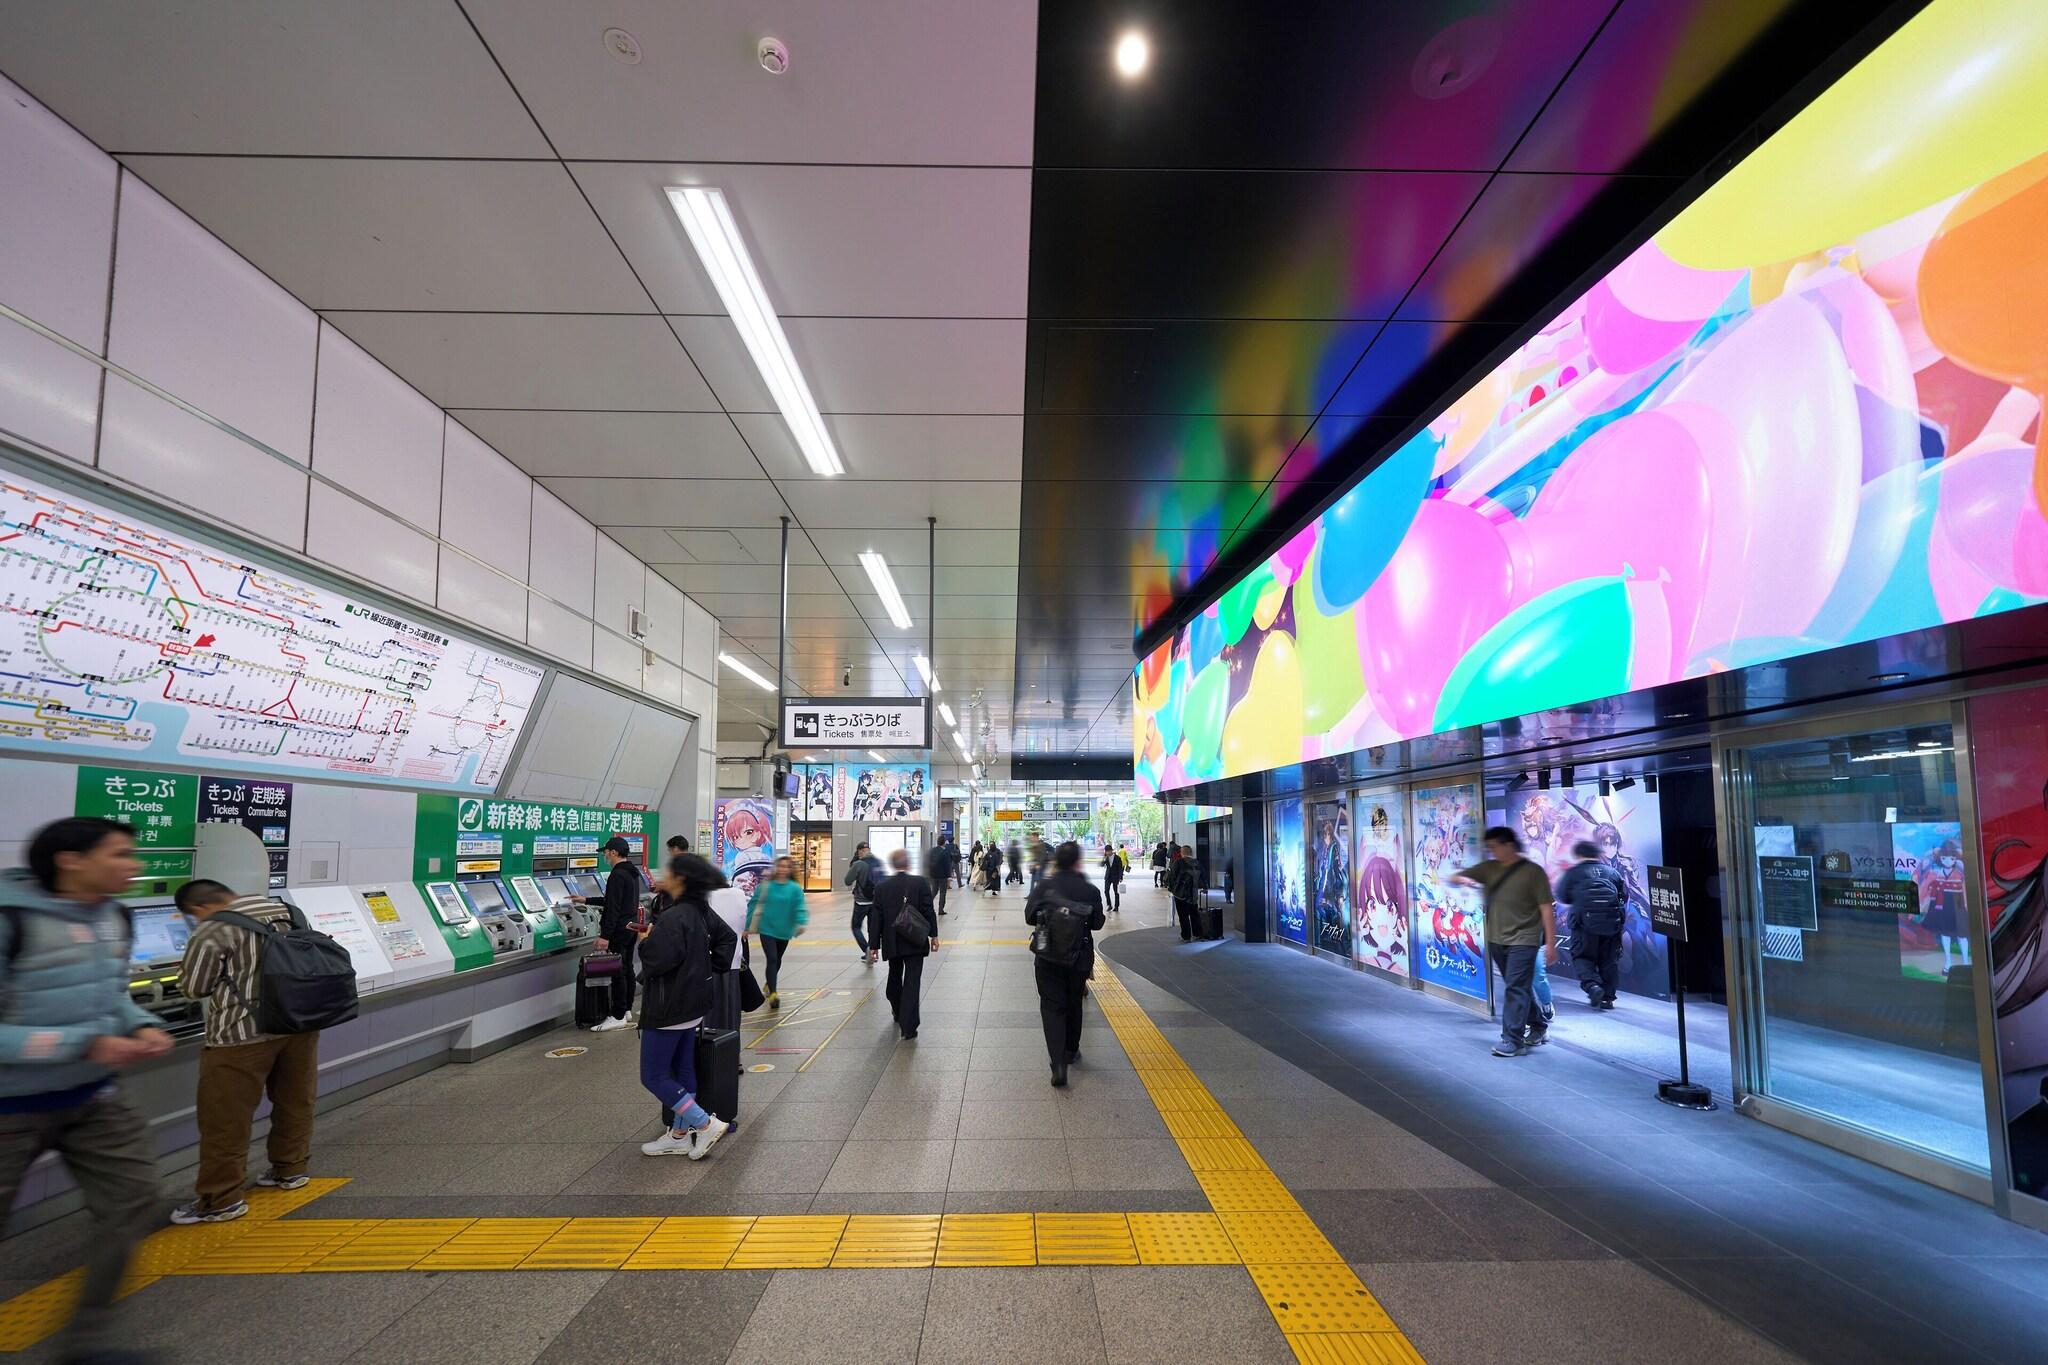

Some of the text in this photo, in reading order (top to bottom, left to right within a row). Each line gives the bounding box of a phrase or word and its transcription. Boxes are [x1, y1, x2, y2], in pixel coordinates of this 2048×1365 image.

[823, 713, 902, 727] きっぷうりば
[823, 729, 855, 739] Tickets
[104, 776, 176, 798] きっぷ
[208, 783, 286, 805] きっぷ 定期券
[116, 799, 164, 812] Tickets
[212, 804, 239, 815] Tickets
[248, 806, 287, 818] Commuter Pass
[1854, 857, 1917, 868] YOSTAR
[1651, 887, 1681, 910] 営業中
